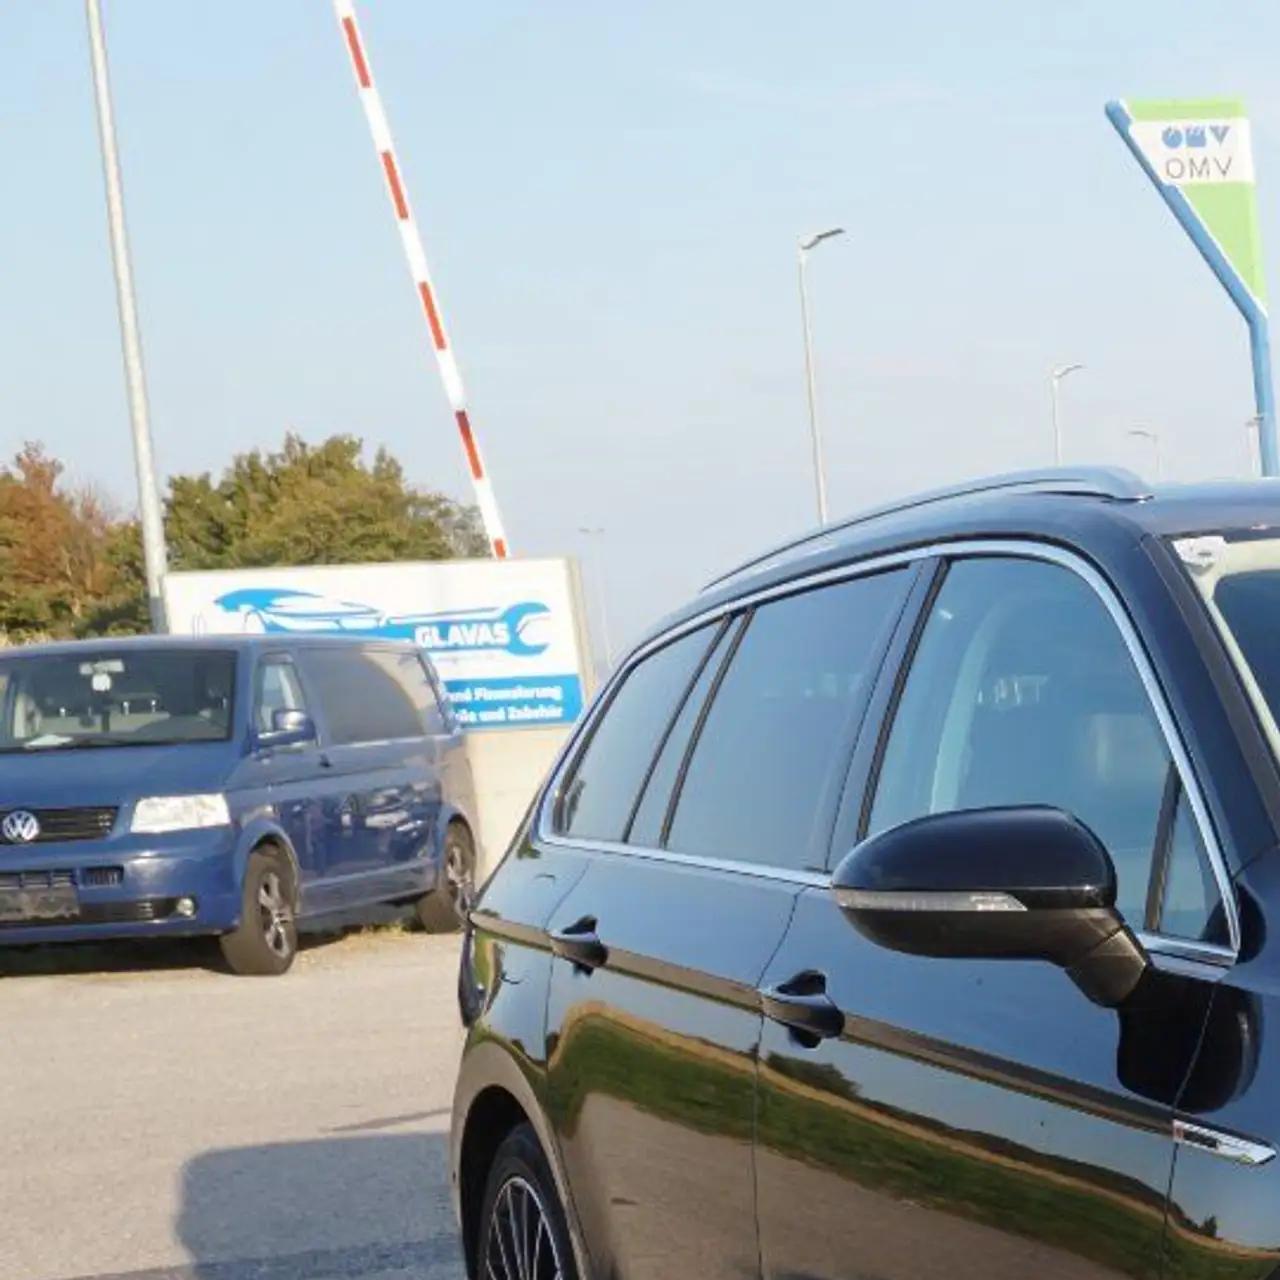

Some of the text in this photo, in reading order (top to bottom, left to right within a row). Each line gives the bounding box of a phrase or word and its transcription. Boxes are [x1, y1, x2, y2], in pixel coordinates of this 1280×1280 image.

[1165, 155, 1233, 179] OMV
[414, 622, 510, 648] GLAVAS
[474, 685, 563, 702] Finanzierung
[479, 707, 505, 722] und
[507, 705, 563, 721] Zubehör
